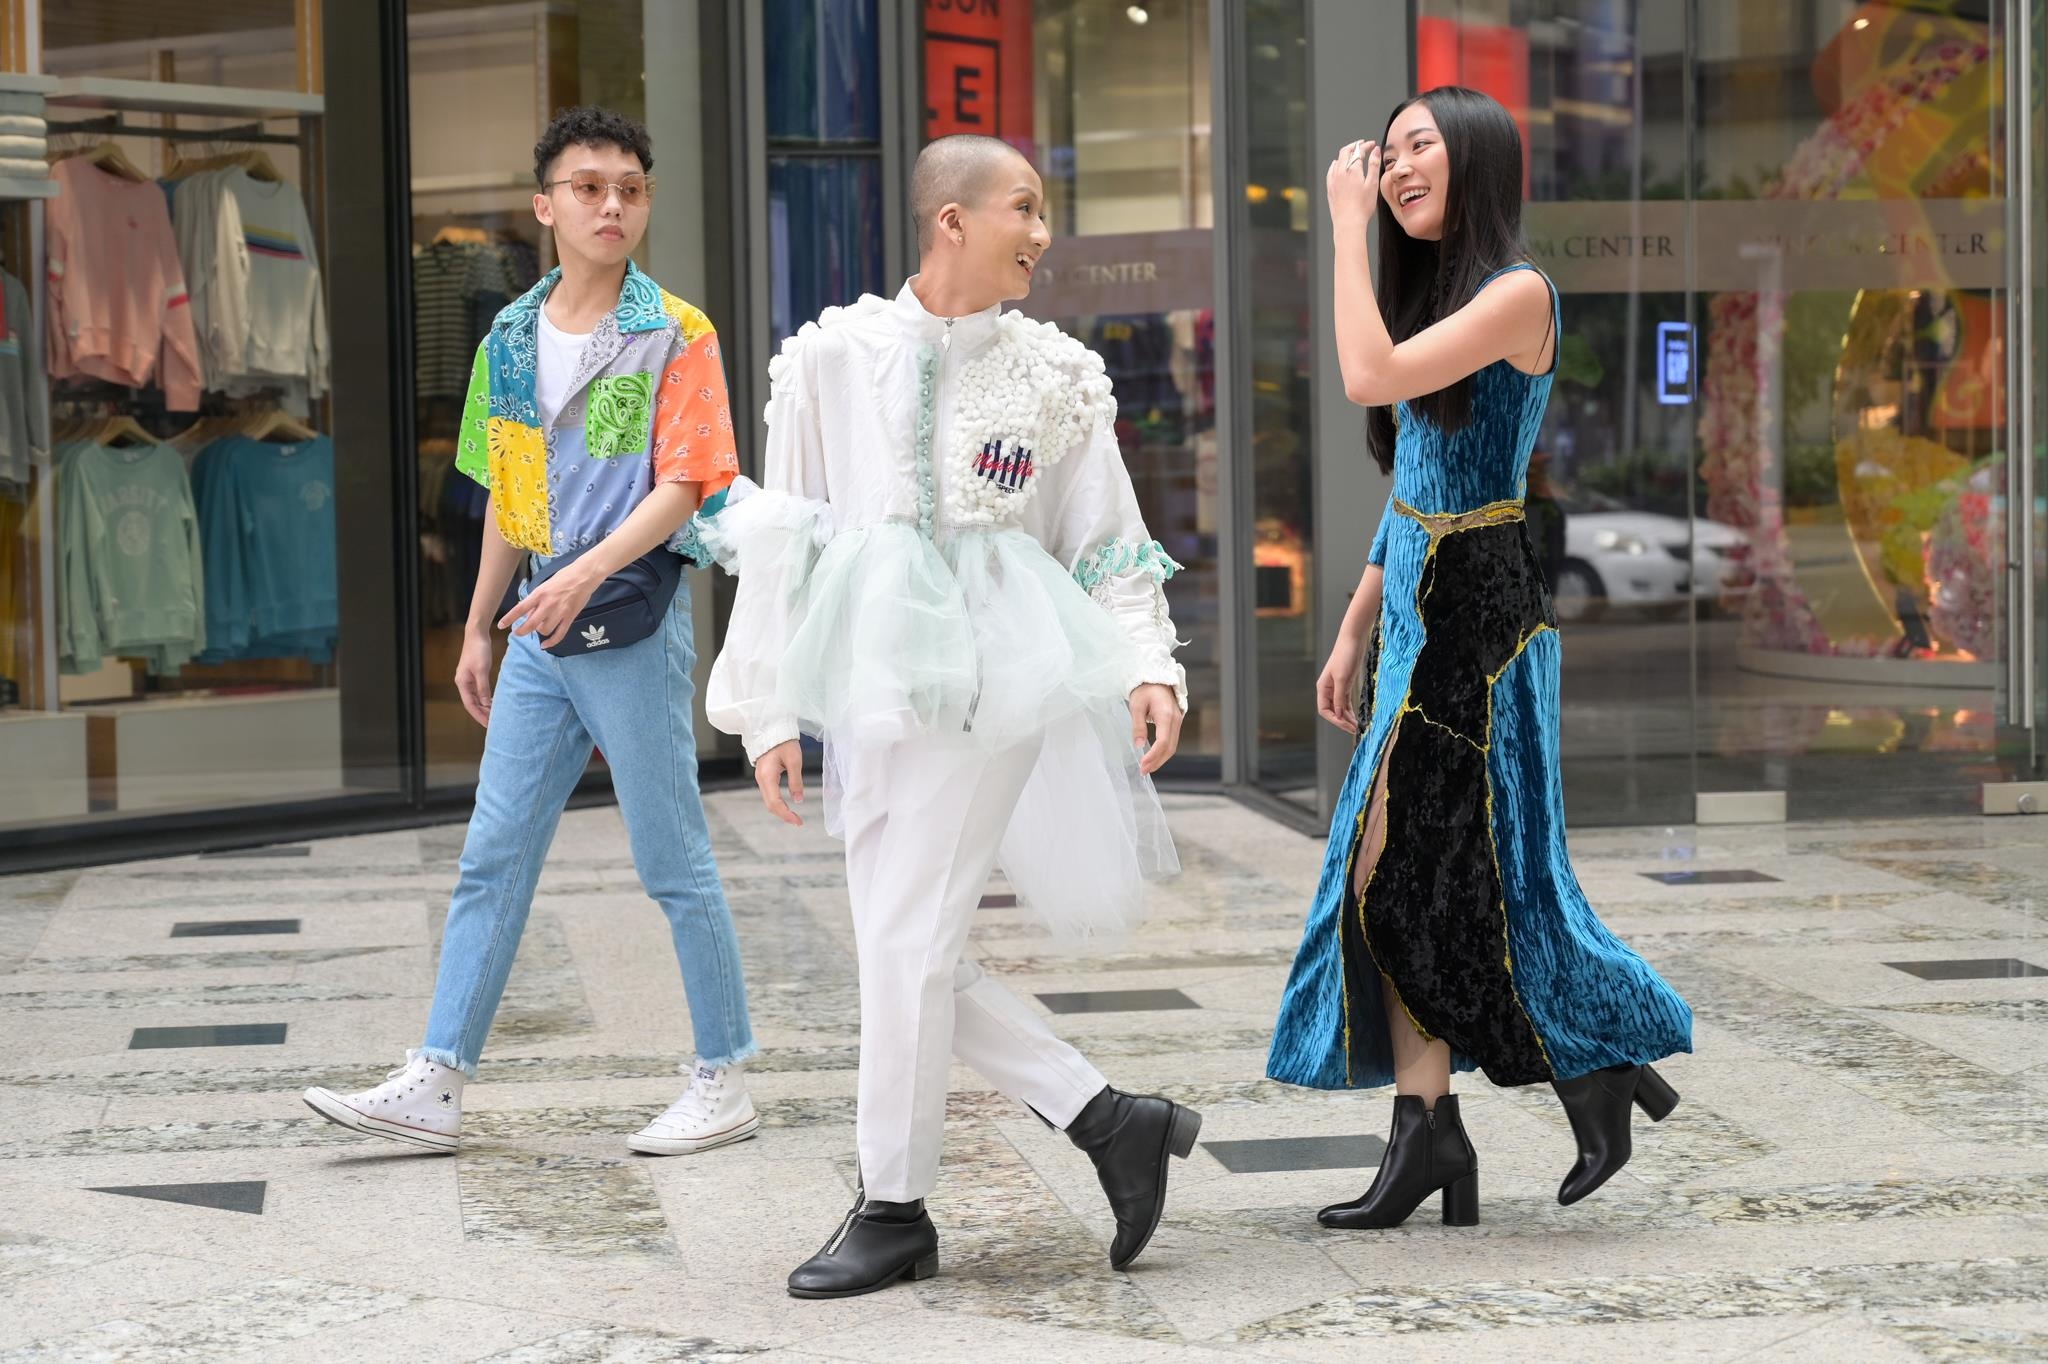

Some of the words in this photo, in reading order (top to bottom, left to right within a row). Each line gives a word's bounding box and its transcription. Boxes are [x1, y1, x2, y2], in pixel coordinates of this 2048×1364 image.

[1563, 235, 1675, 258] CENTER
[1882, 232, 1988, 255] CENTER
[1073, 261, 1158, 286] CENTER
[586, 638, 610, 648] adidas
